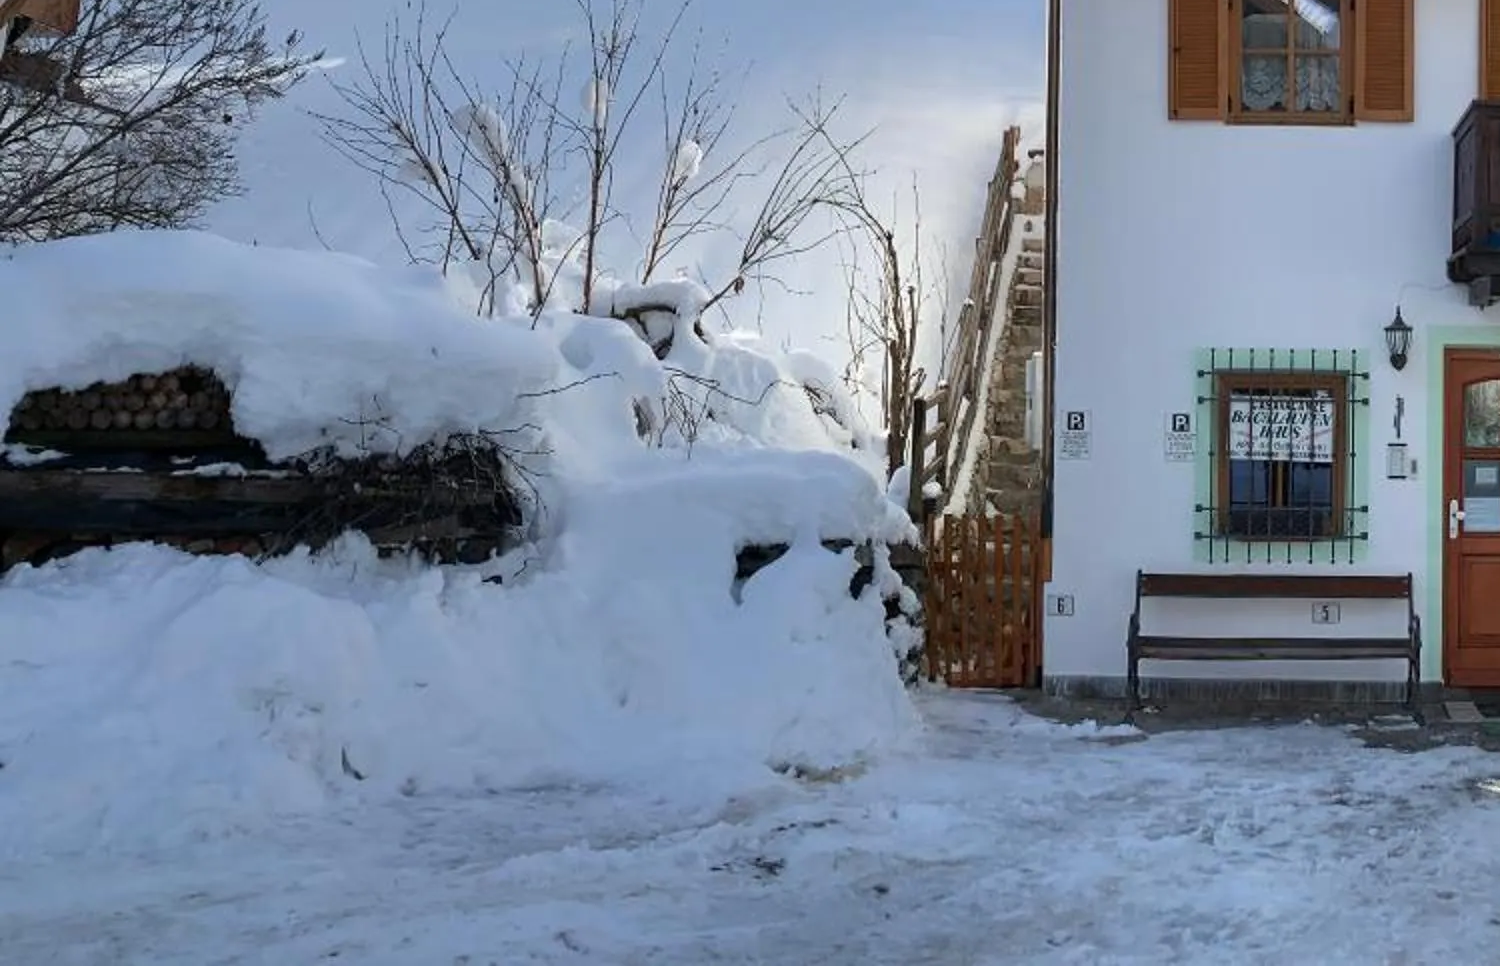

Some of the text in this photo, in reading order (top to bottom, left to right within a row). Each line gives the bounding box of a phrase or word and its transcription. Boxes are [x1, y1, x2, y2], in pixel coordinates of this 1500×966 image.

[1259, 425, 1302, 439] HAUS
[1057, 597, 1065, 615] 6
[1321, 605, 1329, 622] 5
